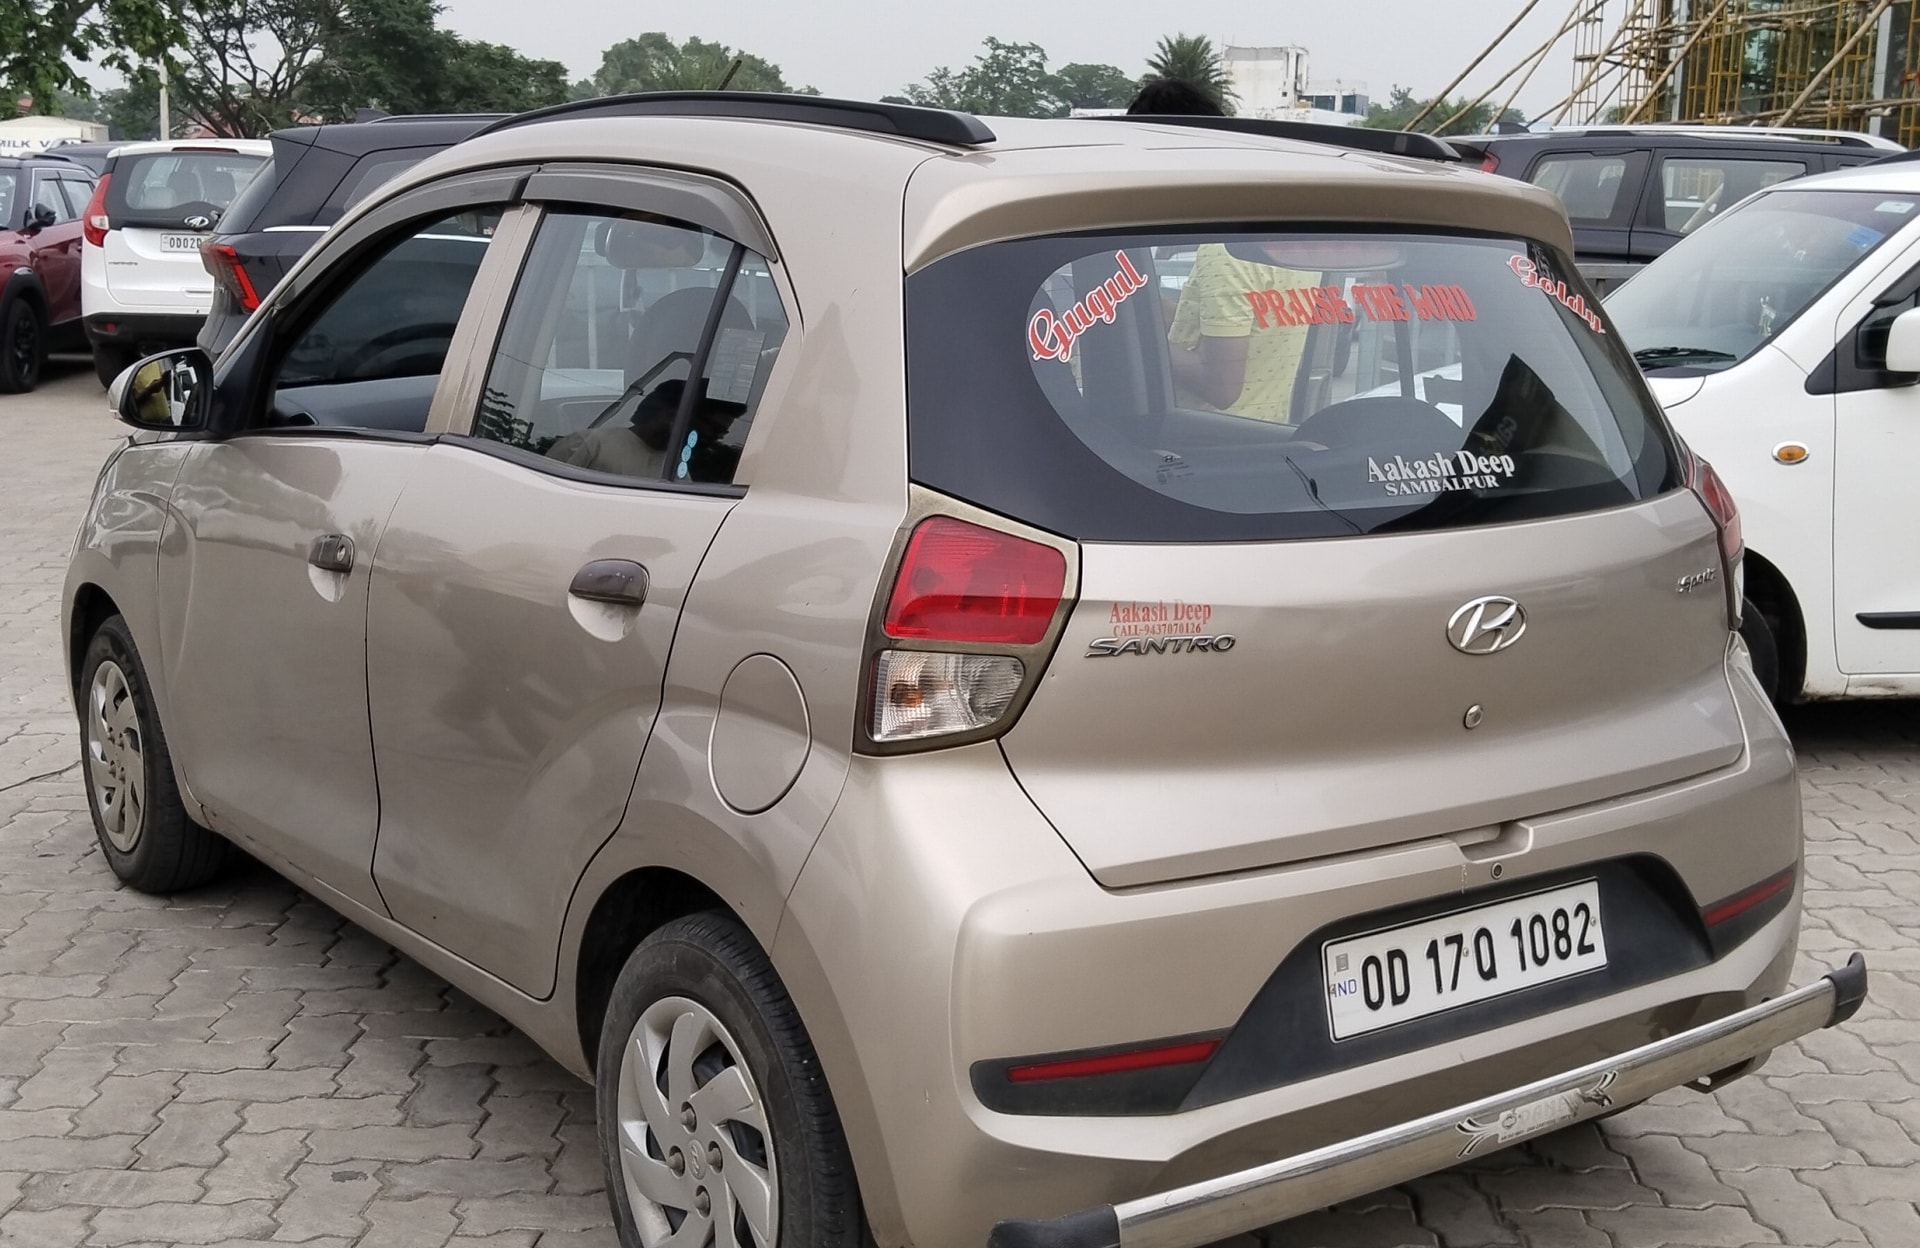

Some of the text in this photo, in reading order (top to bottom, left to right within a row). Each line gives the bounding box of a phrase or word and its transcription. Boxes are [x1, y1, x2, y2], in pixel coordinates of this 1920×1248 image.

[1245, 283, 1477, 330] PRAISE THE LORD
[1506, 254, 1607, 334] Goldy
[1367, 449, 1515, 483] Aakash Deep
[1384, 474, 1500, 497] SAMBALPUR
[1109, 600, 1212, 625] Aakash Deep
[1084, 634, 1237, 659] SANTRO
[1511, 902, 1597, 972] 1082
